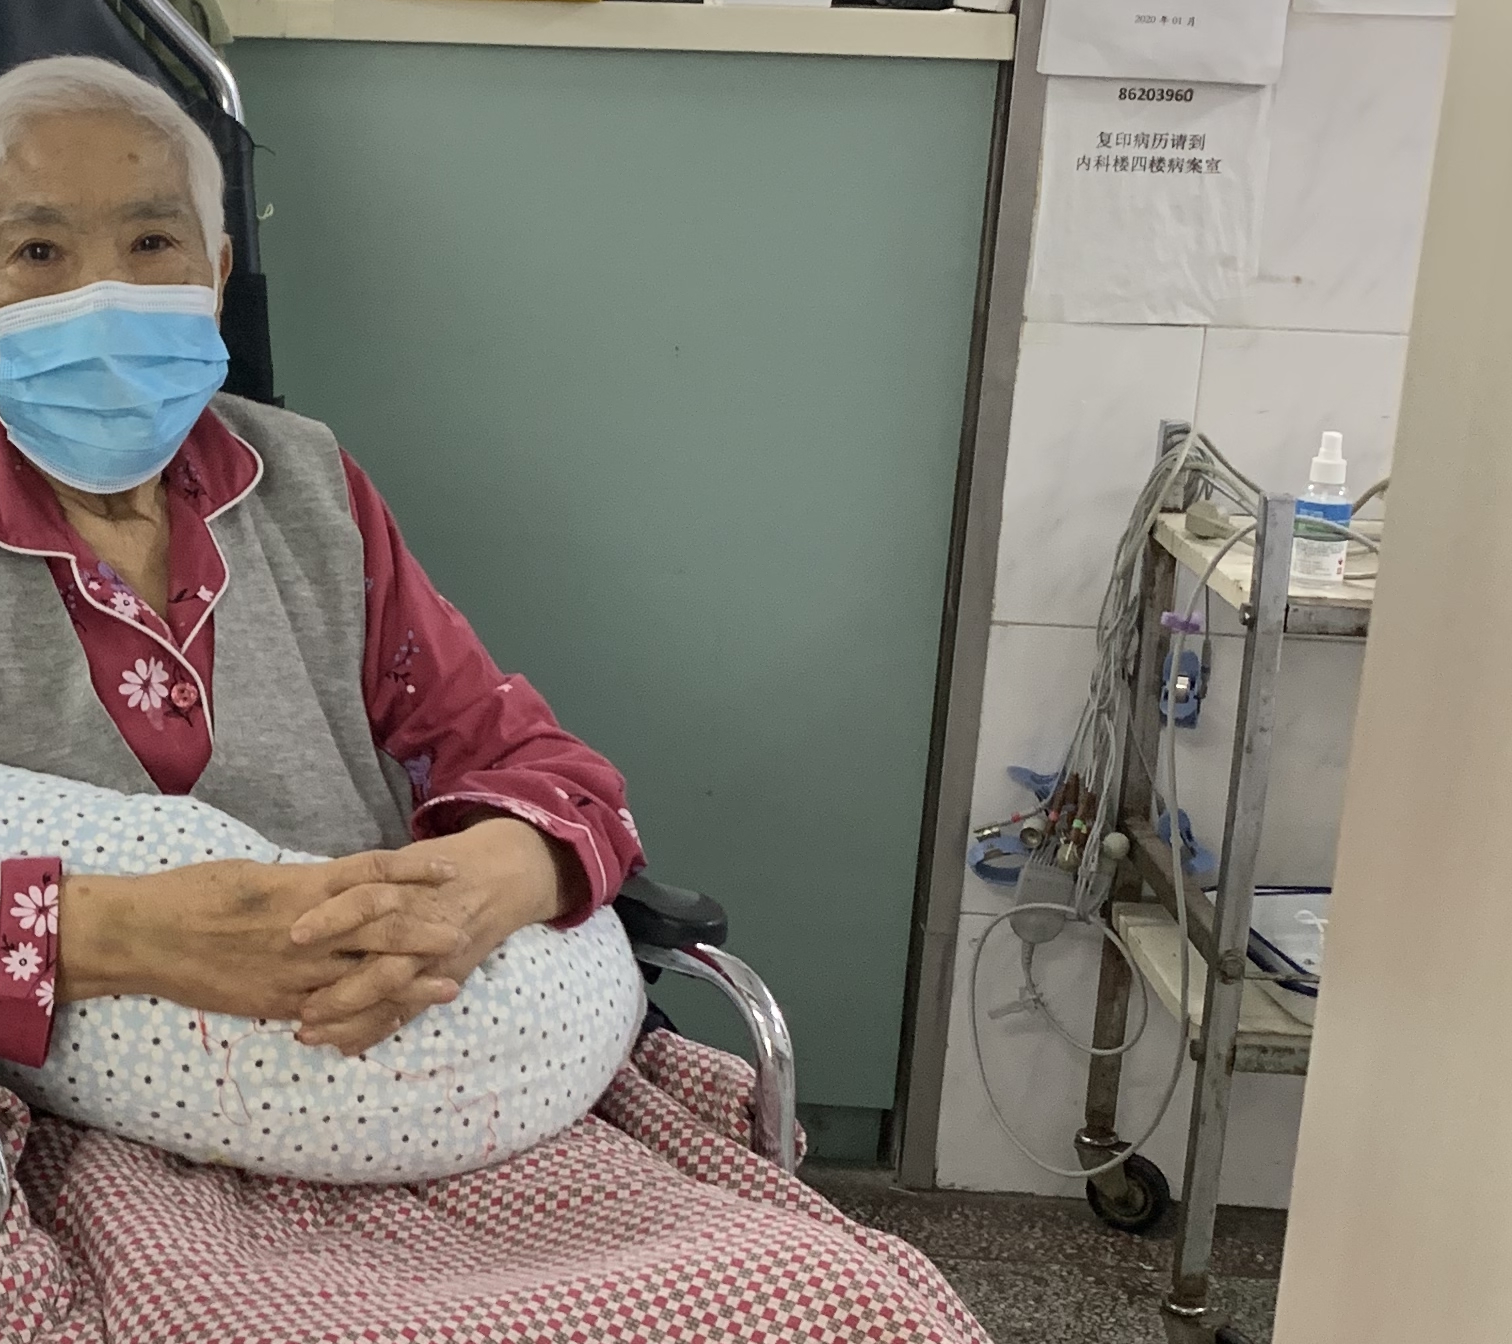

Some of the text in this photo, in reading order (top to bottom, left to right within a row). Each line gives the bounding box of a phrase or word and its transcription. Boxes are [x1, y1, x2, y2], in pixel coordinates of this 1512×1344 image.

[1117, 86, 1194, 104] 86203960
[1095, 130, 1206, 152] 复印病历请到
[1075, 154, 1223, 175] 内科楼四楼病案室
